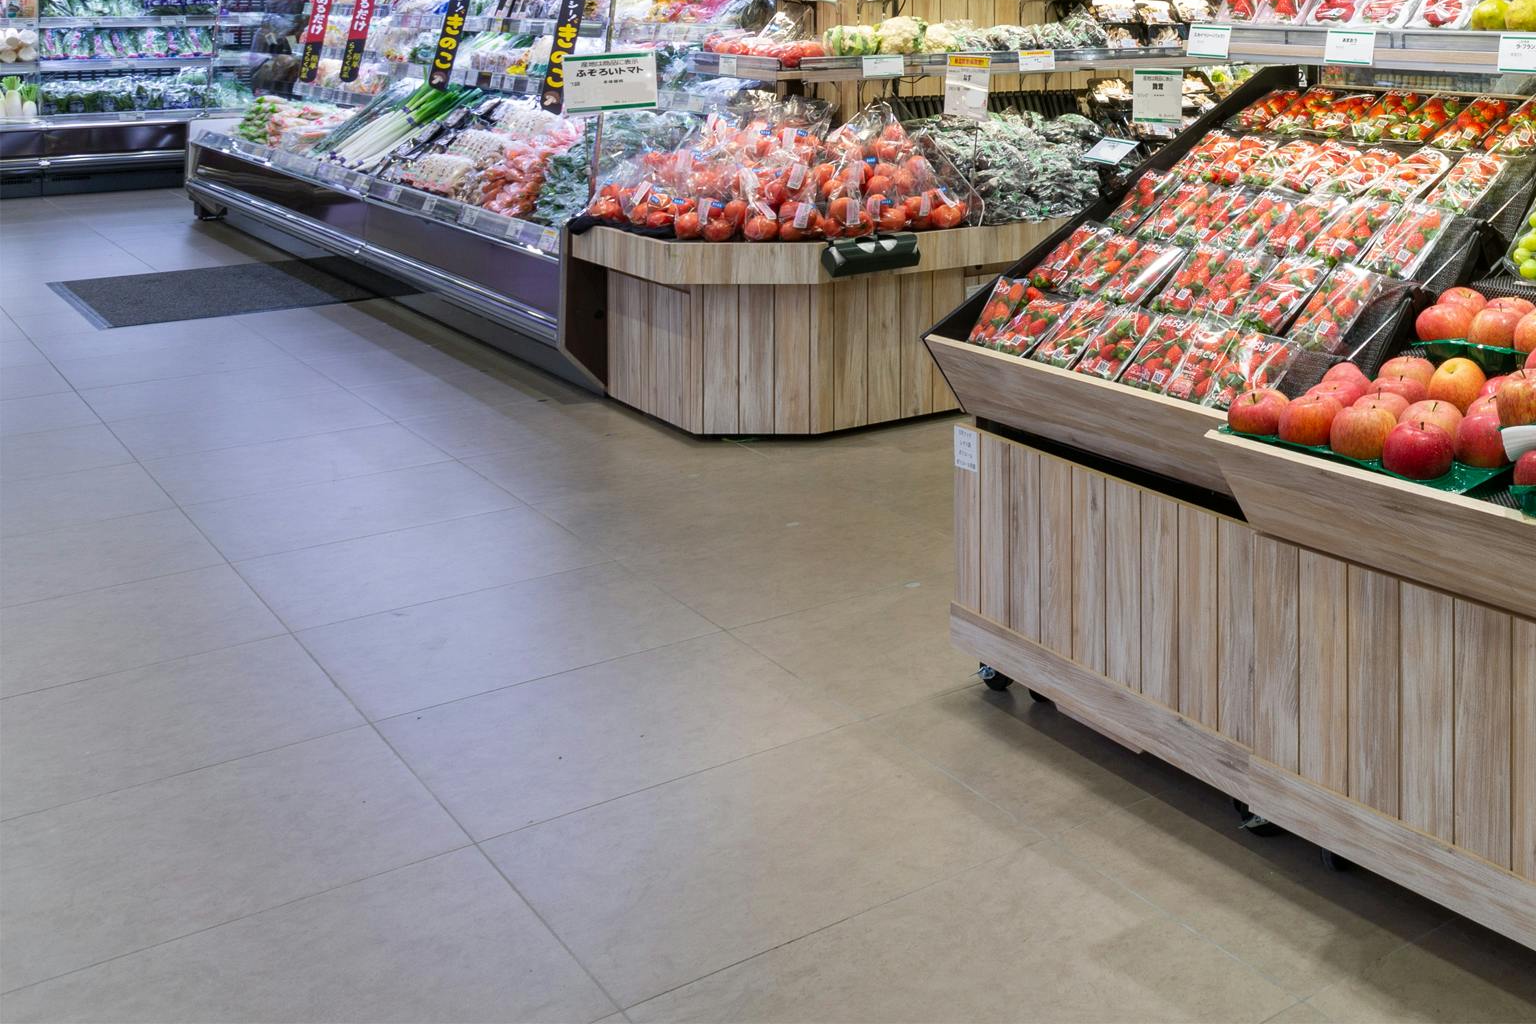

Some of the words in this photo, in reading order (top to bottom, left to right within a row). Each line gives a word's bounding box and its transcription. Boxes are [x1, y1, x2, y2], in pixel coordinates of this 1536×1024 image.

[435, 14, 464, 69] きのこ
[546, 24, 578, 88] きのこ
[576, 67, 644, 77] ふぞろいトマト
